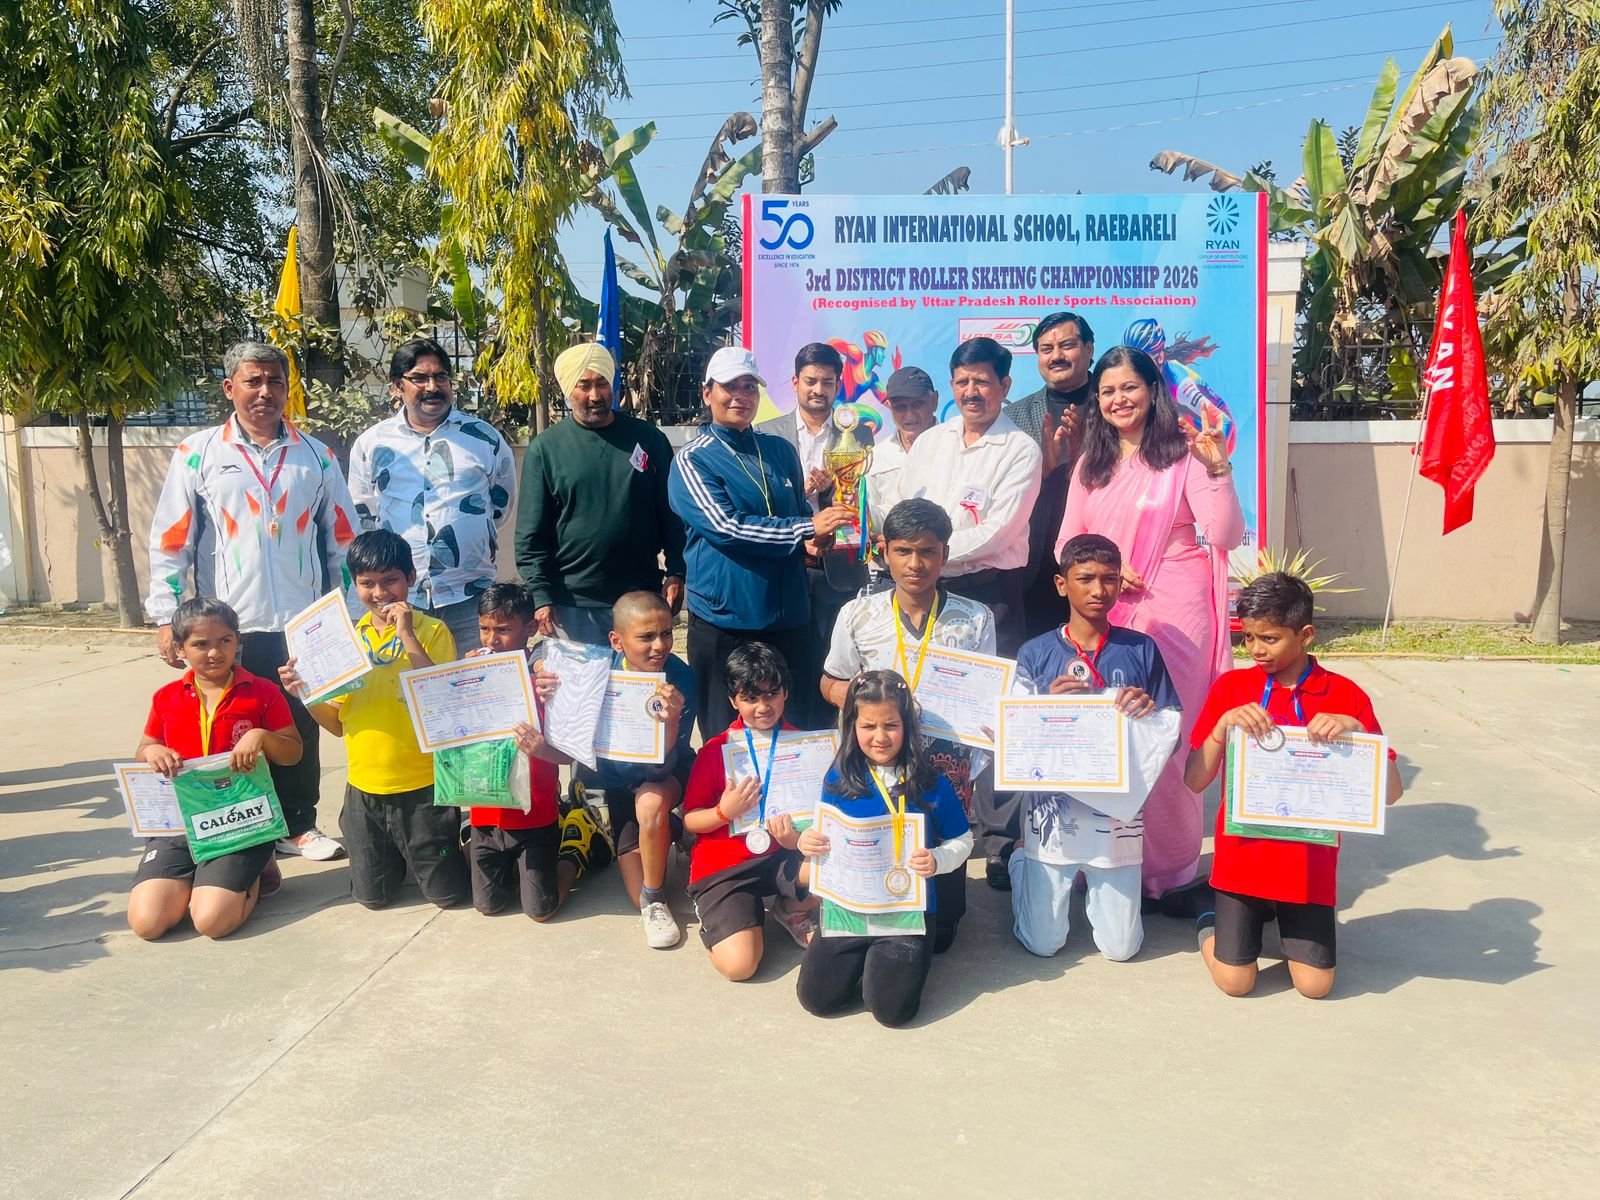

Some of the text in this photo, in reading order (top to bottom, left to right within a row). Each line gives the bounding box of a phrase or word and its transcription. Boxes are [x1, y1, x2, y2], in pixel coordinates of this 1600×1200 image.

[759, 200, 814, 250] 50
[835, 214, 1177, 246] RYAN INTERNATIONAL SCHOOL, RAEBARELI
[1206, 240, 1240, 250] RYAN
[806, 265, 1198, 291] 3rd DISTRICT ROLLER SKATING CHAMPIONSHIP 2026
[812, 294, 1197, 310] (Recognised by Uttar Pradesh Roller Sports Association)
[200, 805, 263, 830] CALGARY
